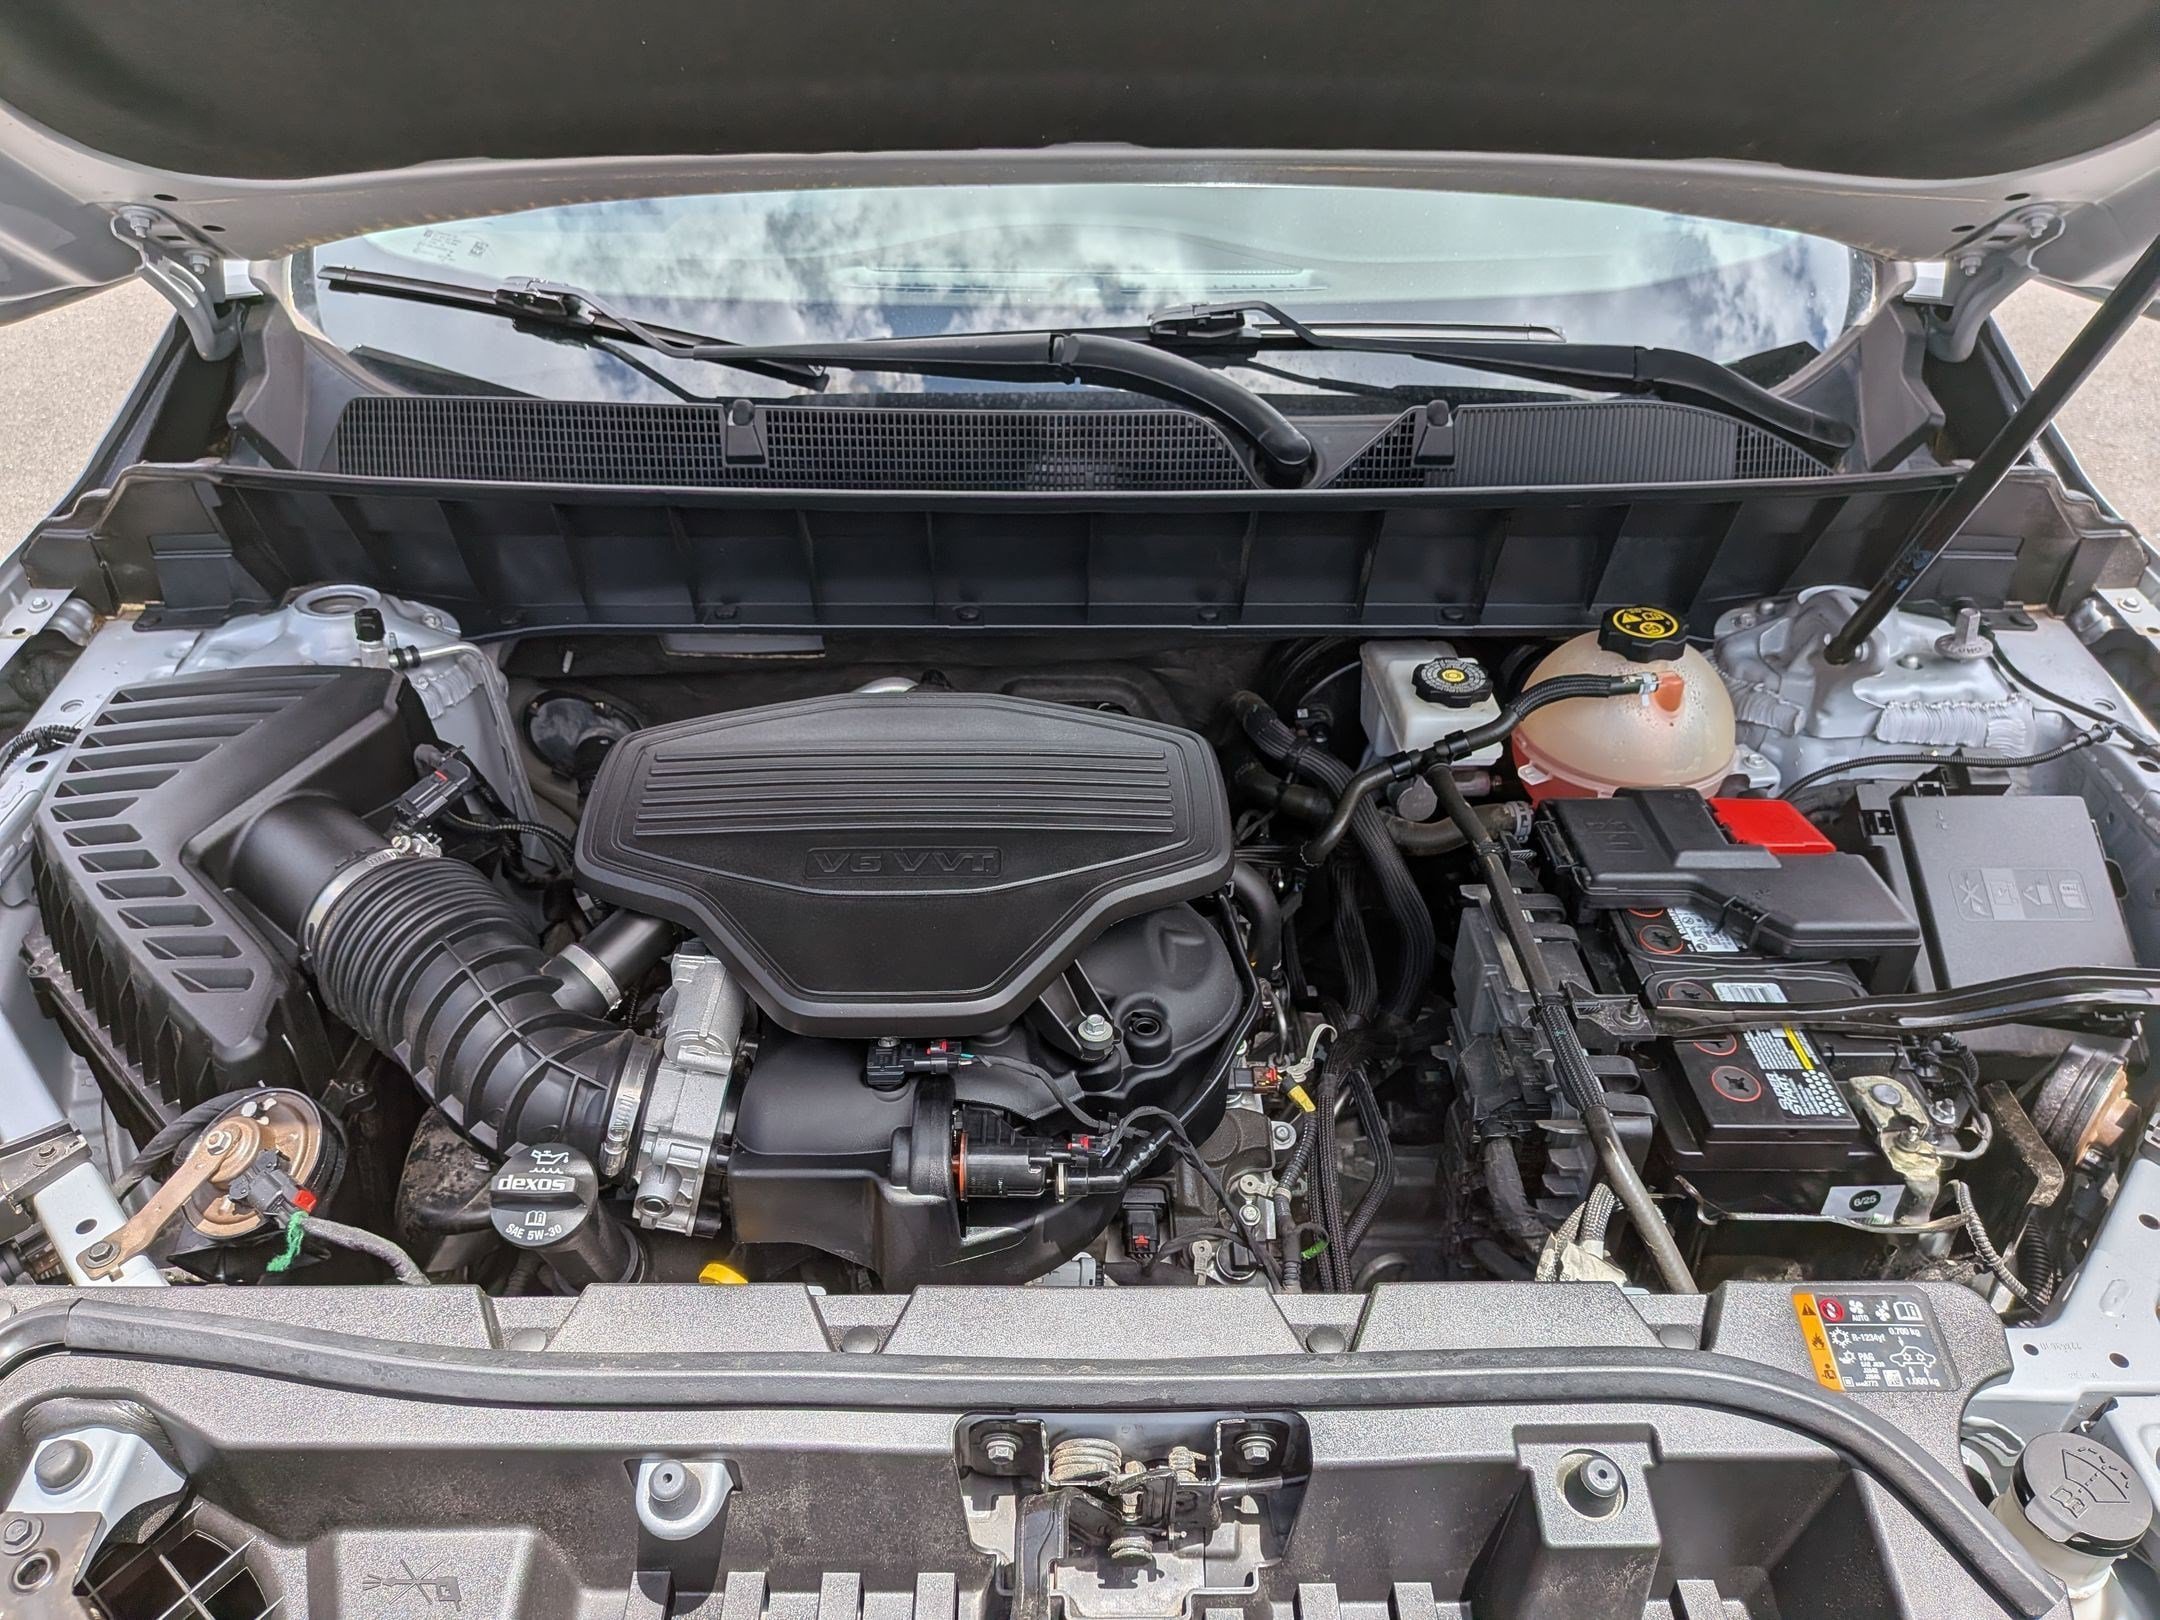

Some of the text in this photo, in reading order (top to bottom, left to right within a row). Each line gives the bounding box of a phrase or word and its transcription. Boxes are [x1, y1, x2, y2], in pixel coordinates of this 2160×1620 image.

[814, 851, 995, 873] V6 VVT
[498, 1175, 566, 1191] dexos
[505, 1223, 563, 1241] SAE 5W-30
[1857, 1352, 1875, 1361] PAG
